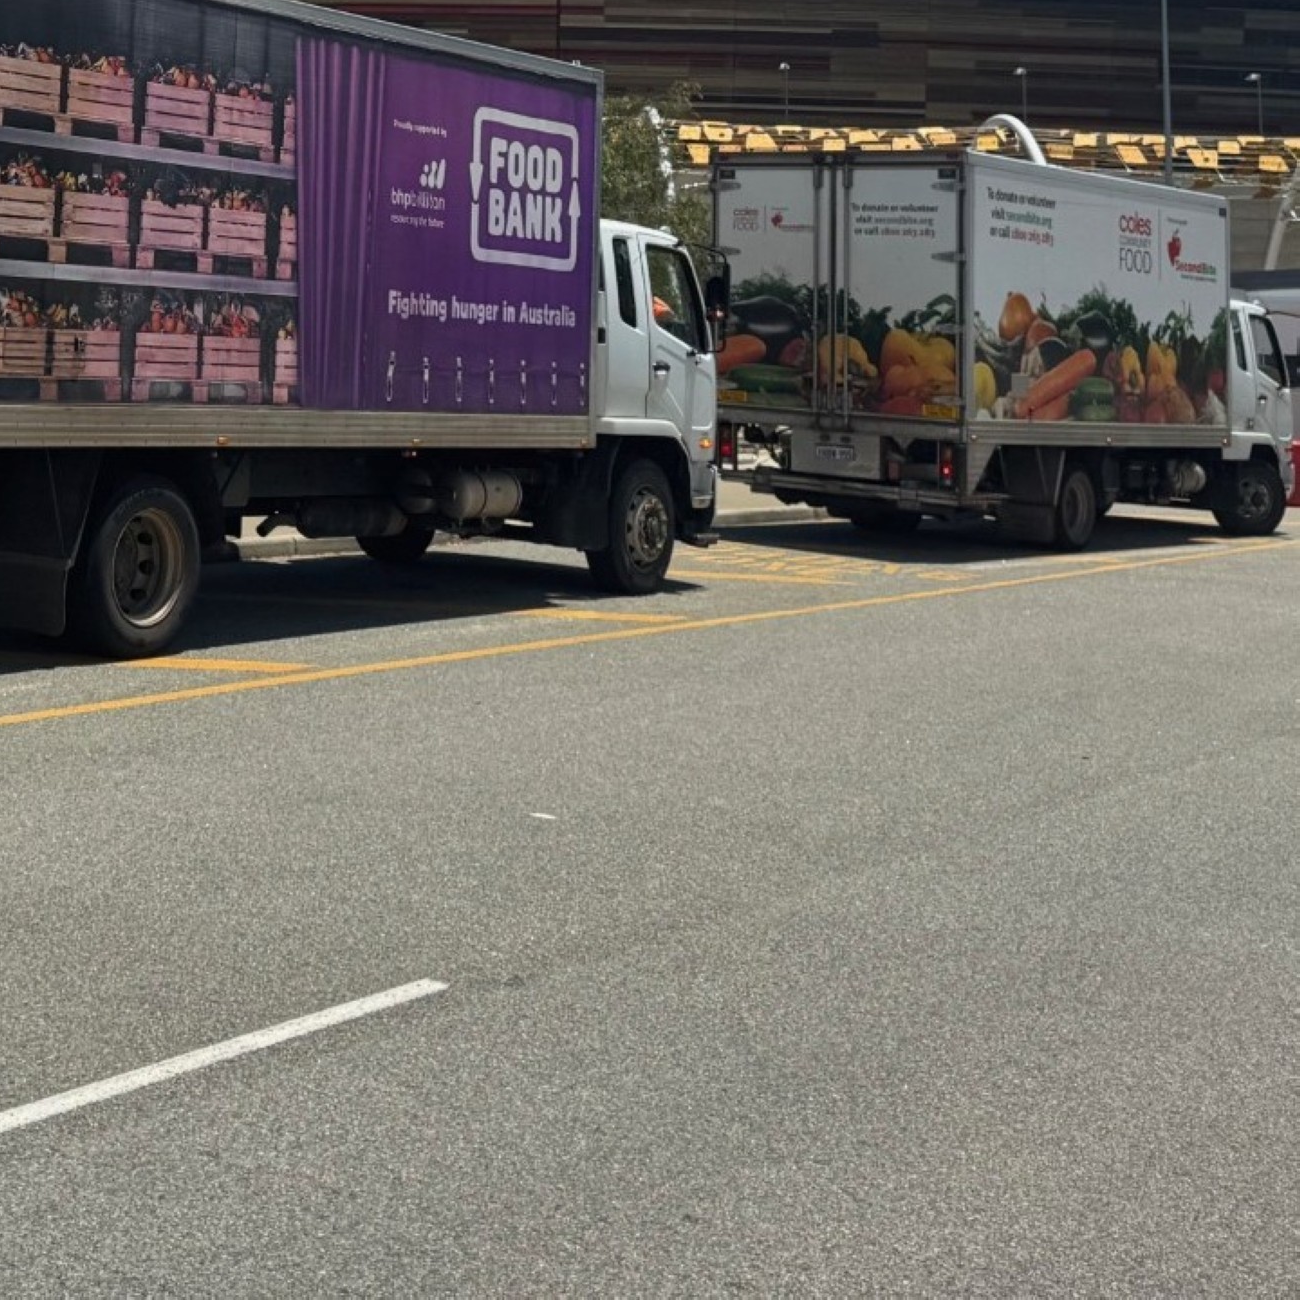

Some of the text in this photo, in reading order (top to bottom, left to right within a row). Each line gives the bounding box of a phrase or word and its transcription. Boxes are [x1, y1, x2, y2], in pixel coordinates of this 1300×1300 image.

[489, 136, 563, 193] FOOD
[487, 187, 563, 244] BANK
[1119, 211, 1152, 236] coles
[1119, 247, 1152, 274] FOOD
[387, 289, 576, 328] Fighting hunger in Australia
